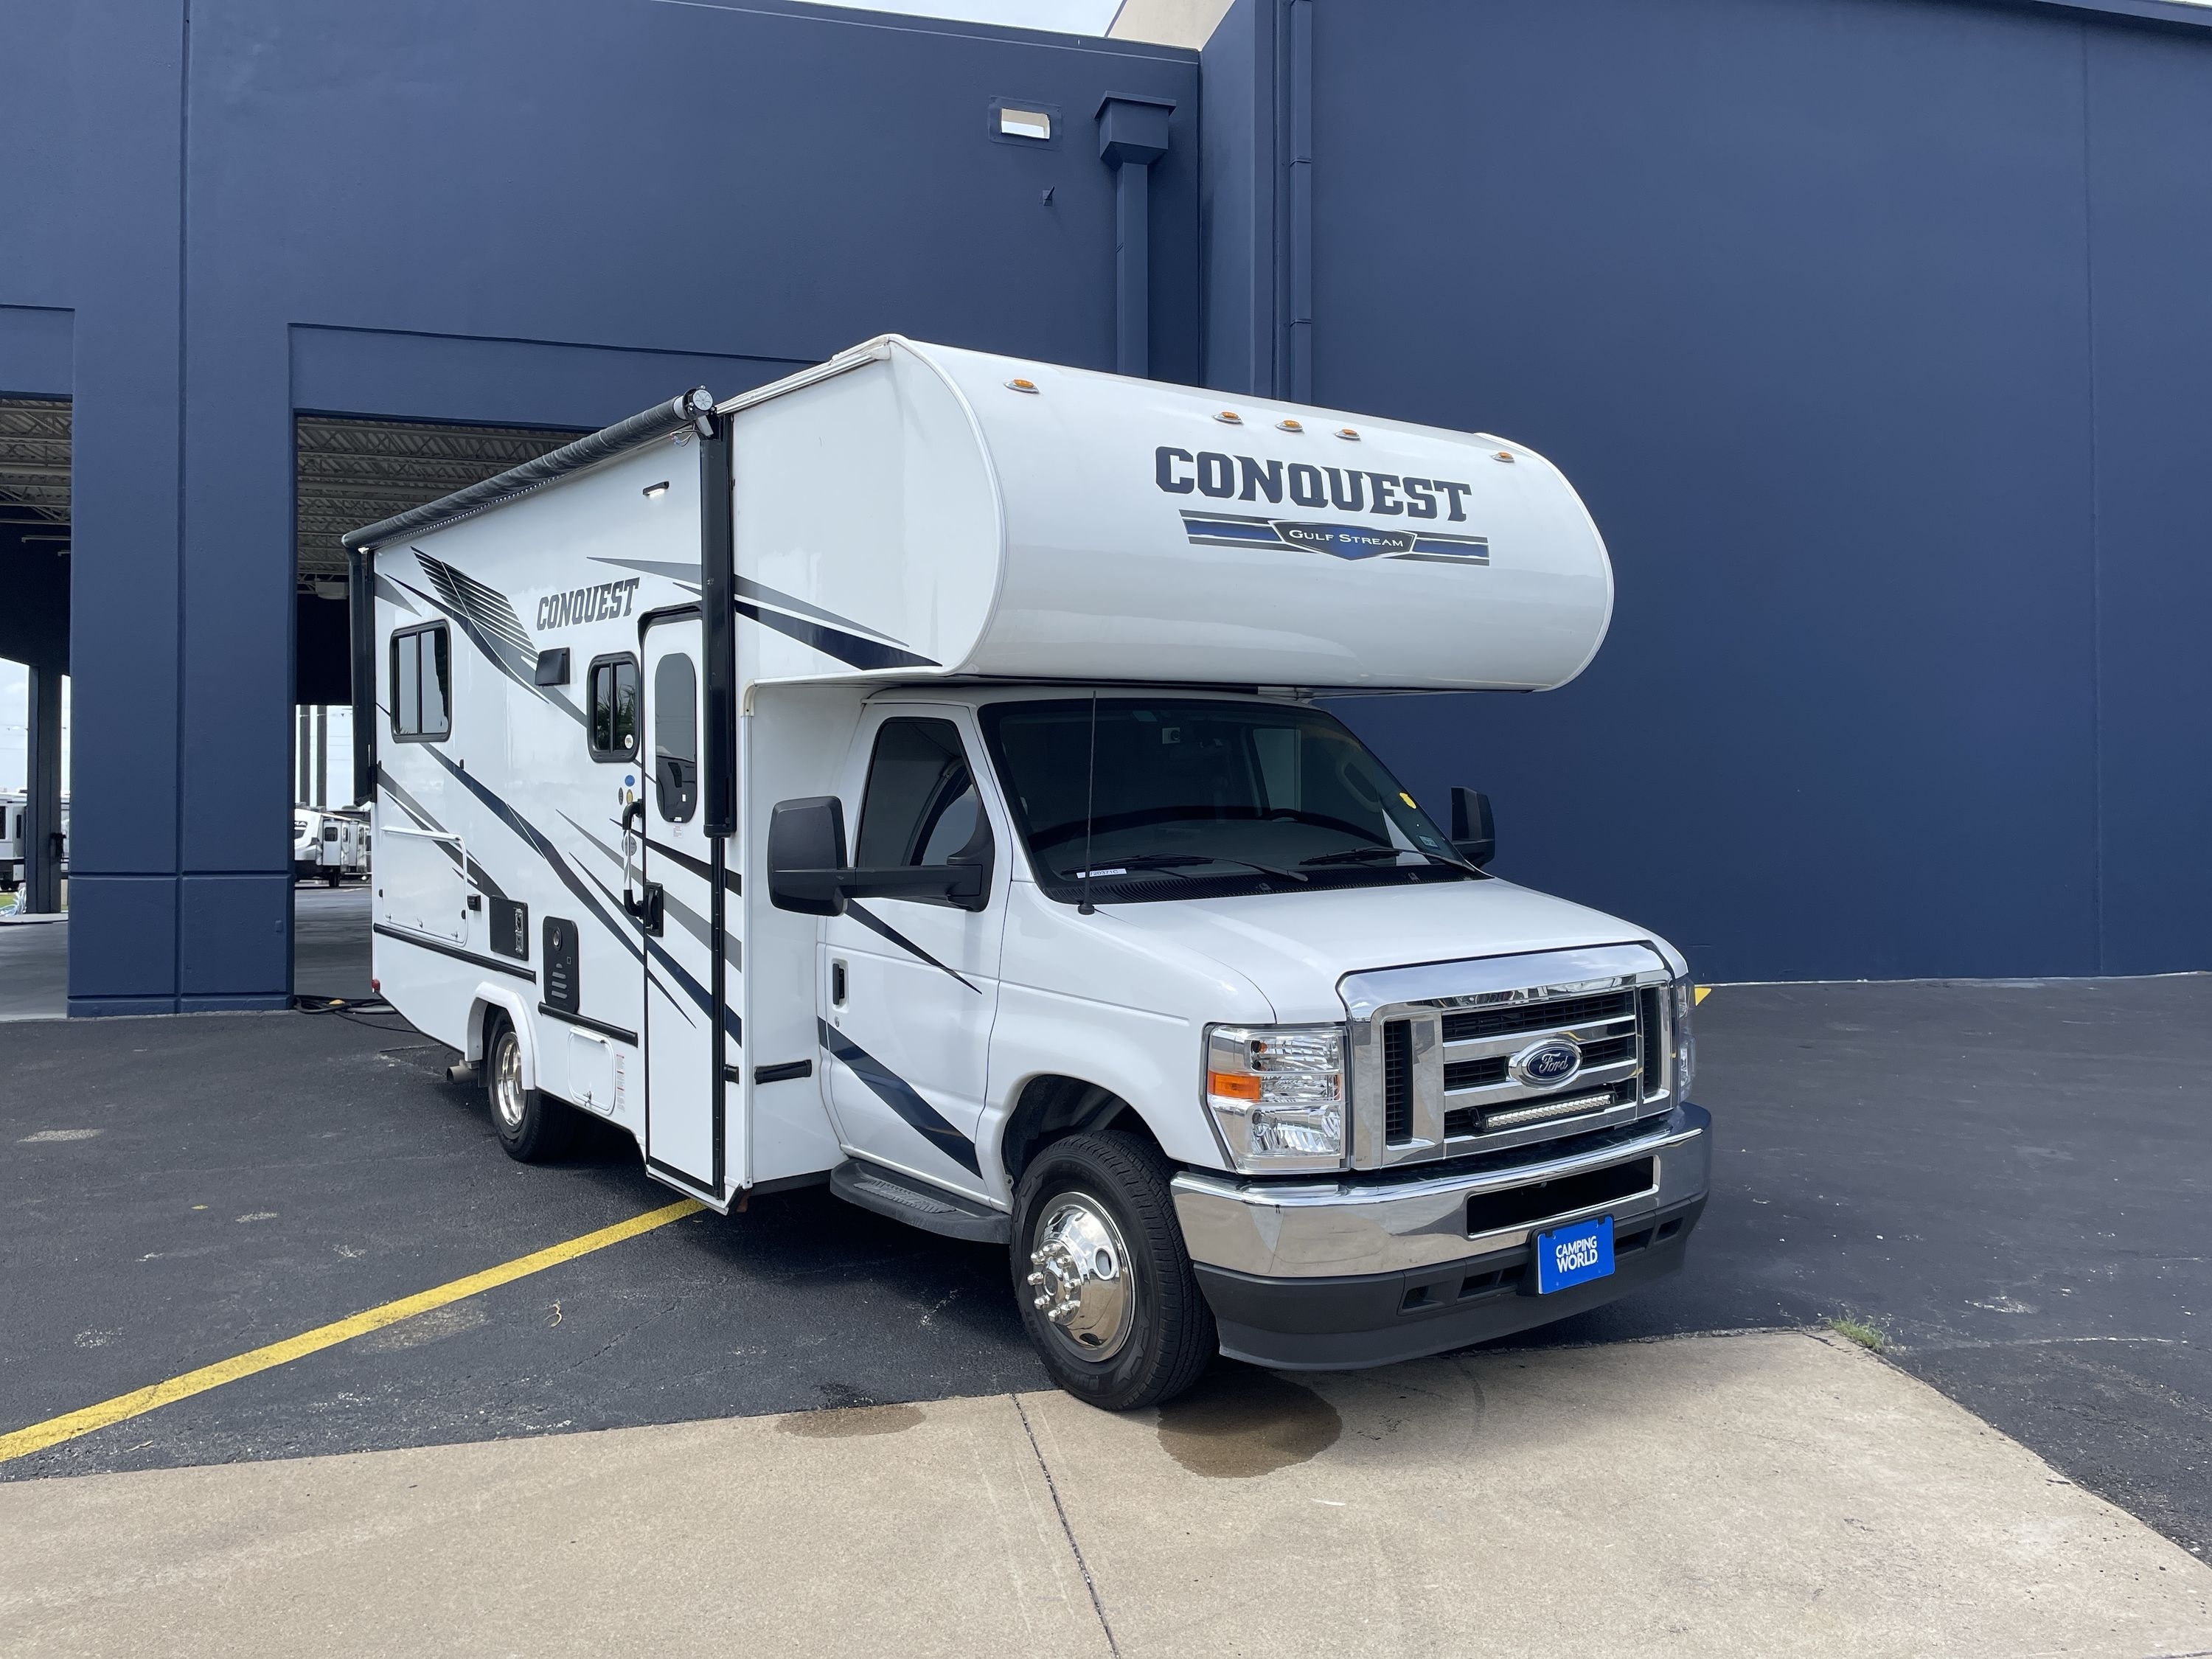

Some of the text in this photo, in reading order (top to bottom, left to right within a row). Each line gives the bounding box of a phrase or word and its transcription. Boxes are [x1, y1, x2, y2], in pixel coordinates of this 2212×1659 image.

[1155, 446, 1472, 522] CONQUEST
[1289, 529, 1404, 547] GULF STREAM
[536, 577, 640, 631] CONQUEST
[1538, 1052, 1568, 1074] Ford
[1556, 1235, 1597, 1258] CAMPING
[1557, 1249, 1598, 1273] WORLD
